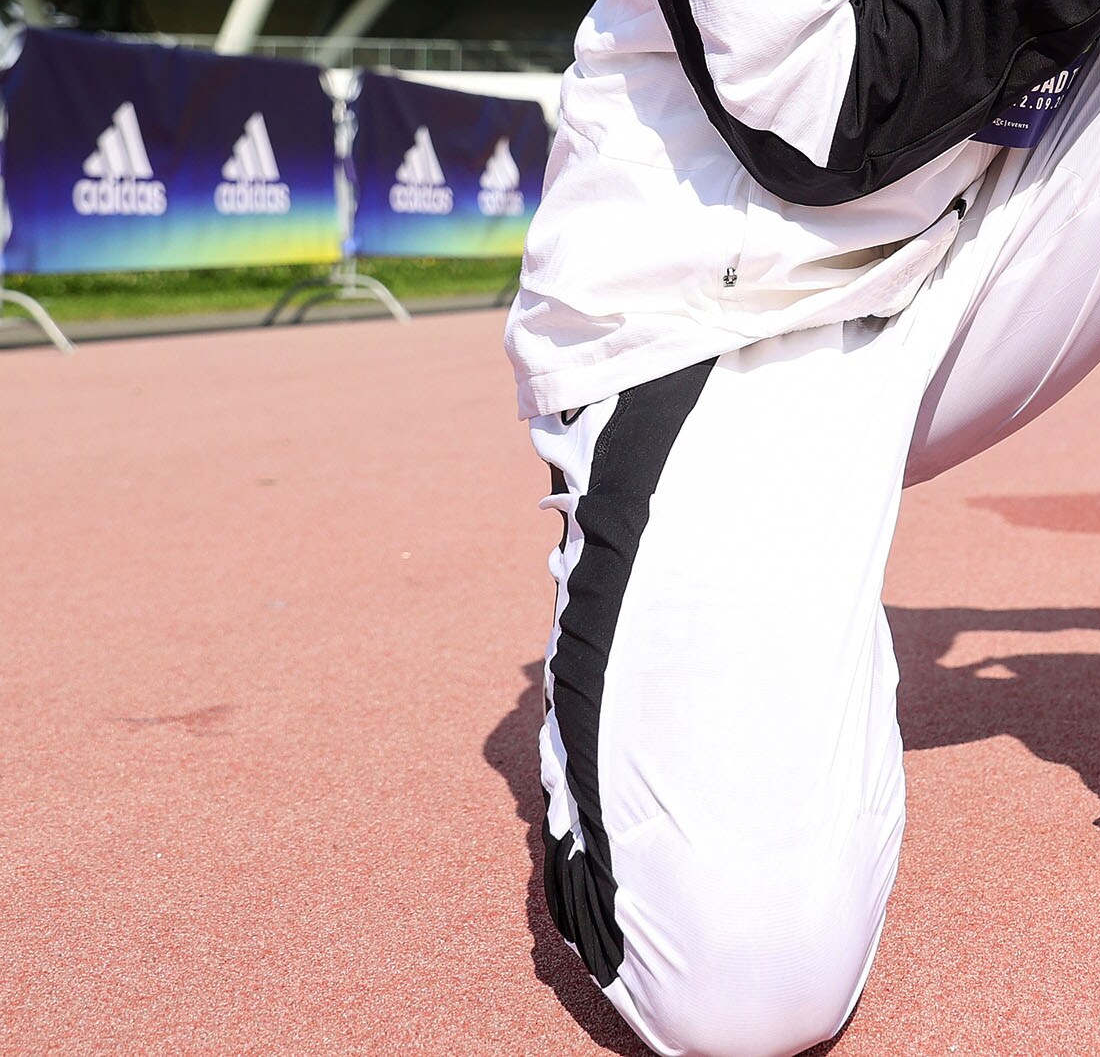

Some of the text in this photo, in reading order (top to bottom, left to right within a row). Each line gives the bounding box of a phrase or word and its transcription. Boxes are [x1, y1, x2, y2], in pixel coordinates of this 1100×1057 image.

[72, 176, 168, 216] adidas
[213, 180, 291, 215] adidas
[389, 182, 455, 215] adidas
